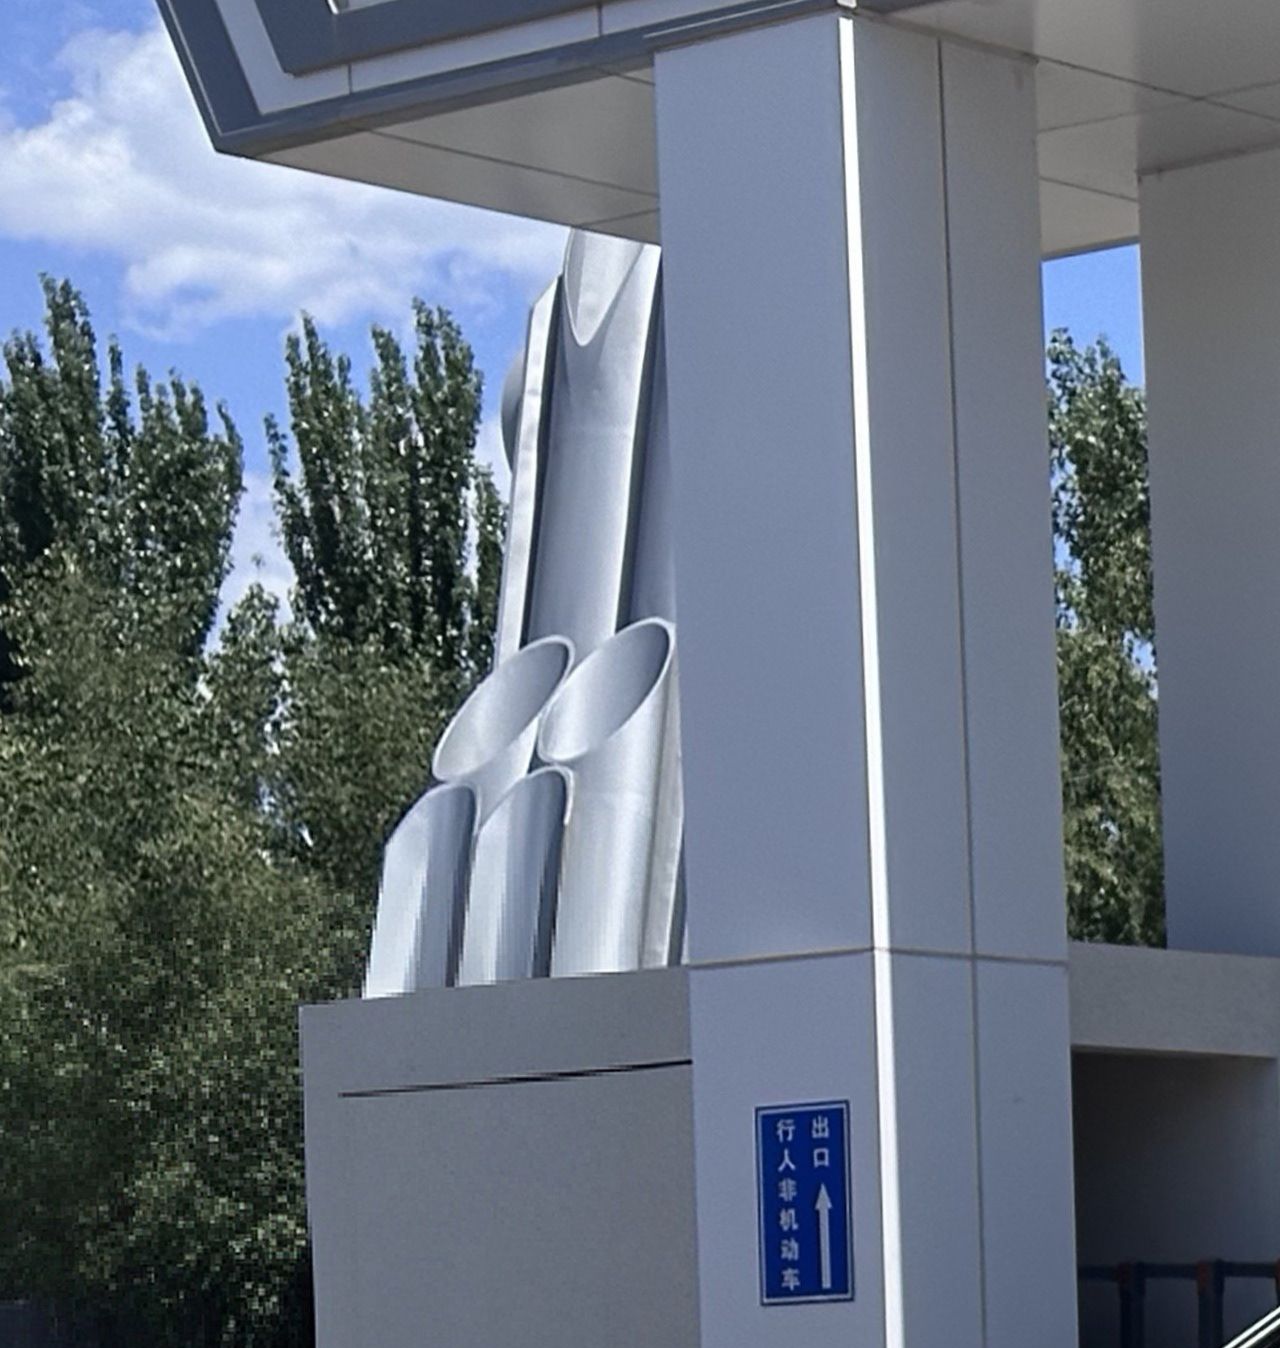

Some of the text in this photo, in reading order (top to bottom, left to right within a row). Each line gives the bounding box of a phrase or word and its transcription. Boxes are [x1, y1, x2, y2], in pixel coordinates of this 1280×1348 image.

[811, 1115, 829, 1167] 出口
[776, 1118, 800, 1292] 行人非机动车
